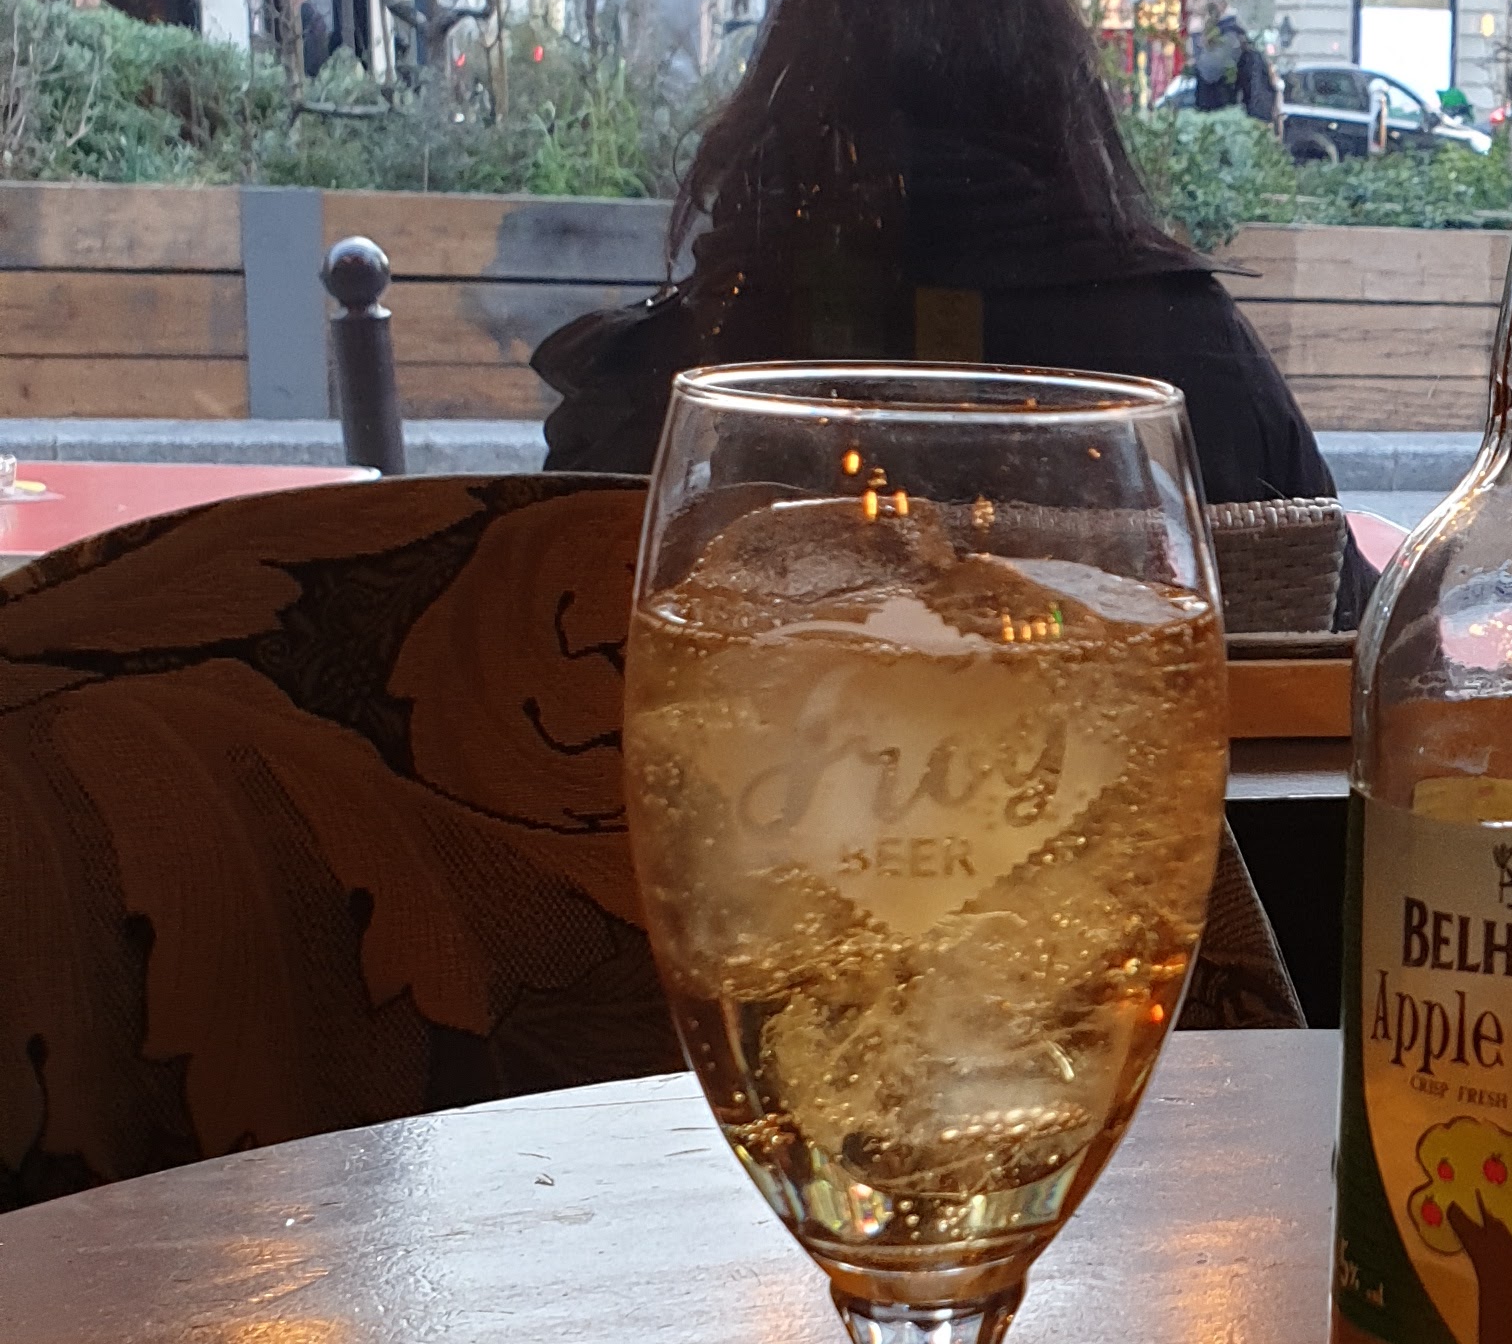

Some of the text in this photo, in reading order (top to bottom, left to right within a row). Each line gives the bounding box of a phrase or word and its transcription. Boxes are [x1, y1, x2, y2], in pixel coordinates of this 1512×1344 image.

[838, 836, 978, 879] BEER
[1369, 968, 1505, 1072] Apple
[1408, 1074, 1450, 1099] CRISP
[1456, 1085, 1509, 1110] FRESH
